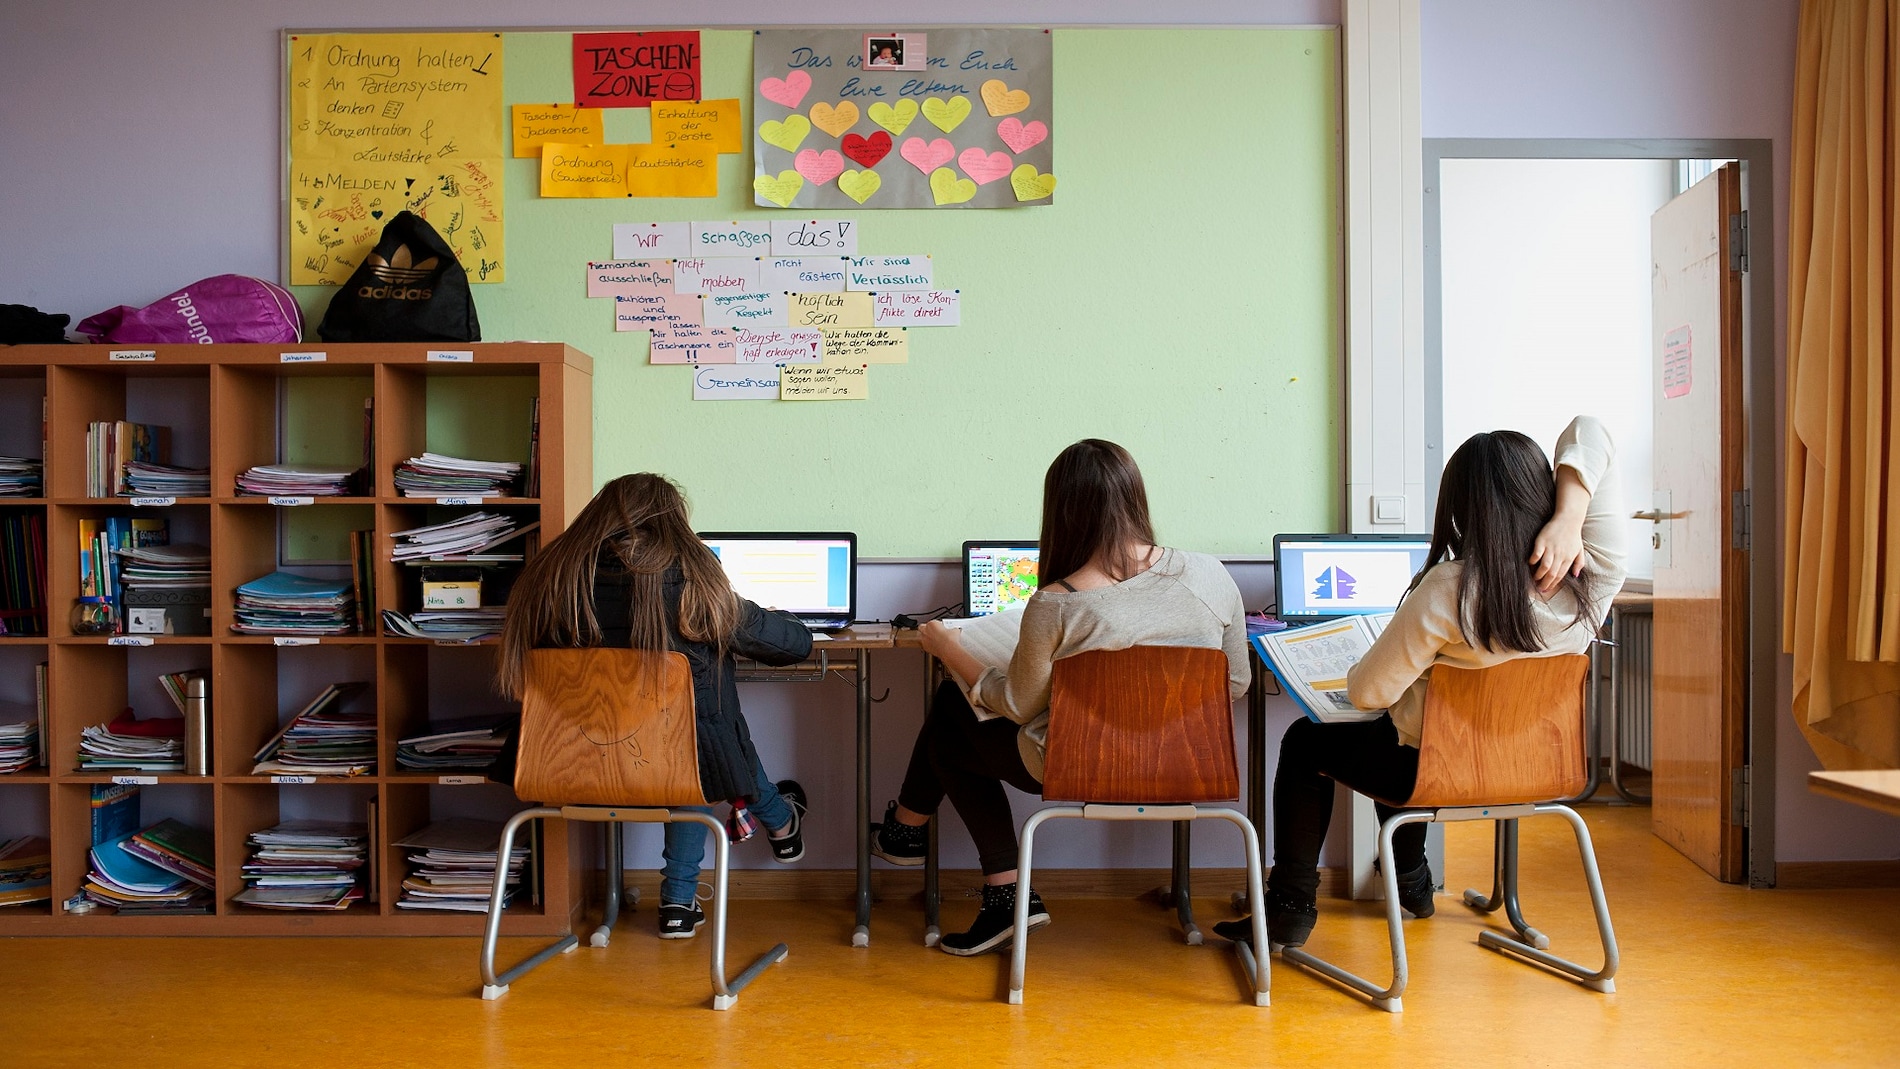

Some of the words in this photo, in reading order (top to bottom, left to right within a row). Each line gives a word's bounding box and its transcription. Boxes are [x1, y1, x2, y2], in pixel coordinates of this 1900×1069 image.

[327, 45, 401, 77] Ordnung
[417, 47, 474, 68] halten
[584, 44, 699, 71] TASCHEN-
[787, 47, 832, 68] Das
[960, 50, 1018, 71] Euch
[323, 76, 345, 92] An
[588, 73, 663, 98] ZONE
[840, 77, 887, 97] Eure
[899, 79, 970, 96] Eltern
[326, 100, 375, 115] denken
[658, 109, 718, 122] Einhaltung
[298, 119, 310, 131] 3
[315, 119, 412, 138] Konzentration
[521, 126, 590, 139] Jackenzone
[681, 121, 702, 130] der
[664, 131, 713, 142] Dienste
[353, 147, 432, 164] Lautstärke
[632, 155, 705, 168] Lautstärke
[552, 155, 614, 175] Ordnung
[325, 173, 396, 191] MELDEN
[590, 261, 651, 270] niemanden
[677, 259, 706, 275] nicht
[774, 259, 803, 268] nicht
[850, 257, 875, 267] Wir
[883, 258, 911, 267] sind
[598, 271, 672, 287] ausschließen
[701, 275, 746, 293] mobben
[851, 272, 930, 286] Verlässlich
[358, 285, 433, 301] adidas
[902, 293, 923, 305] löse
[926, 292, 958, 306] Kon-
[798, 293, 845, 311] höflich
[643, 306, 666, 314] und
[725, 305, 773, 319] Respekt
[876, 307, 905, 322] flikte
[913, 307, 945, 318] direkt
[669, 321, 701, 329] lassen
[652, 330, 667, 338] Wir
[674, 329, 703, 338] halten
[711, 328, 727, 336] die
[736, 328, 785, 347] Dienste
[825, 330, 842, 339] Wir
[844, 330, 873, 339] halten
[651, 340, 712, 350] Taschenzone
[717, 340, 735, 349] ein
[743, 348, 762, 363] haft
[784, 366, 812, 375] Wenn
[816, 367, 832, 375] wir
[834, 366, 864, 375] etwas
[788, 376, 812, 388] sagen
[136, 496, 169, 504] Hannah
[274, 496, 299, 504] Sarah
